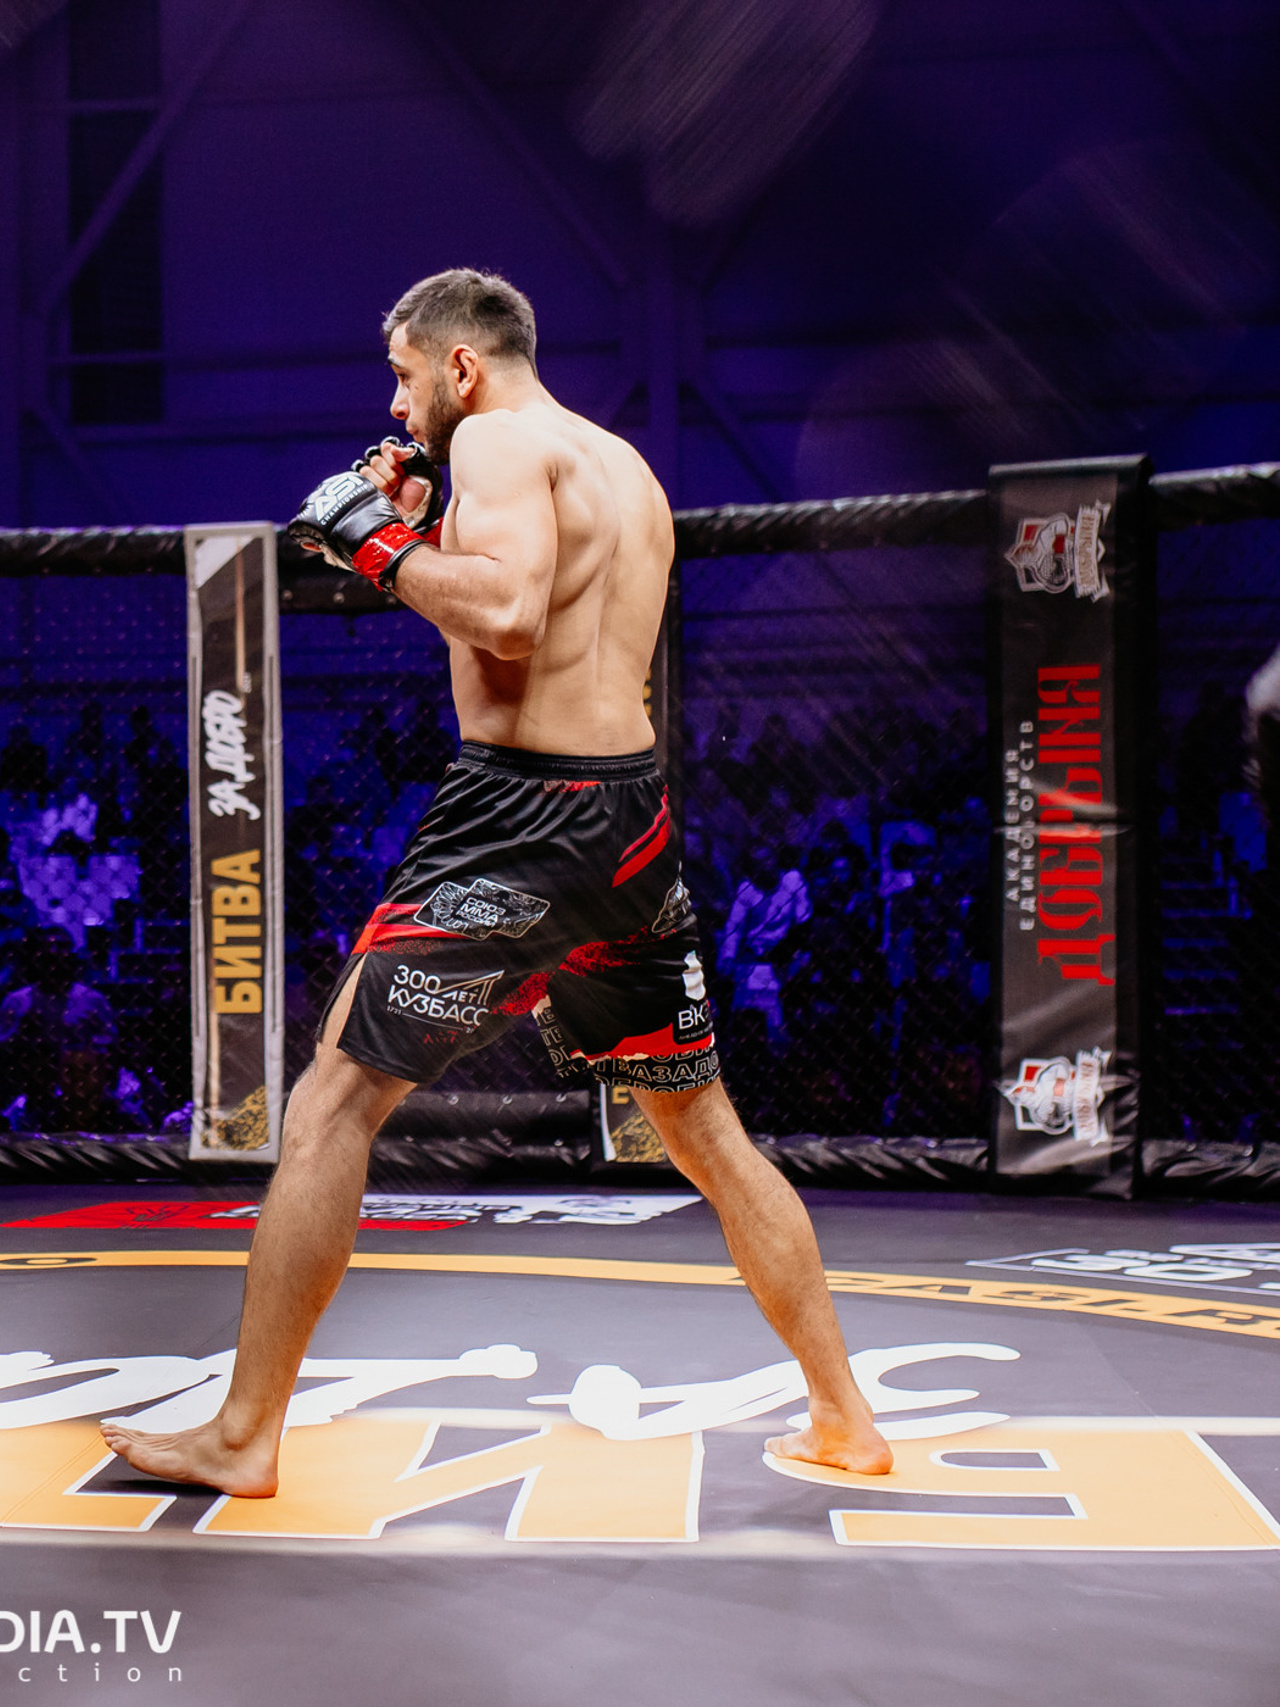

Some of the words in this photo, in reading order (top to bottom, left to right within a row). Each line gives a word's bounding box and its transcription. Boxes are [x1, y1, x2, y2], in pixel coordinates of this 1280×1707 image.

[315, 474, 364, 521] ASI
[320, 484, 369, 526] CHAMPIONSHIP
[201, 689, 256, 783] ДОБРО
[207, 778, 262, 821] ЗА
[1005, 748, 1021, 902] АКАДЕМИЯ
[1037, 663, 1116, 986] ДОБРЫНЯ
[466, 896, 507, 916] СОЮЗ
[211, 848, 264, 1014] БИТВА
[393, 964, 441, 995] 300
[387, 984, 490, 1026] КУЗБАСС
